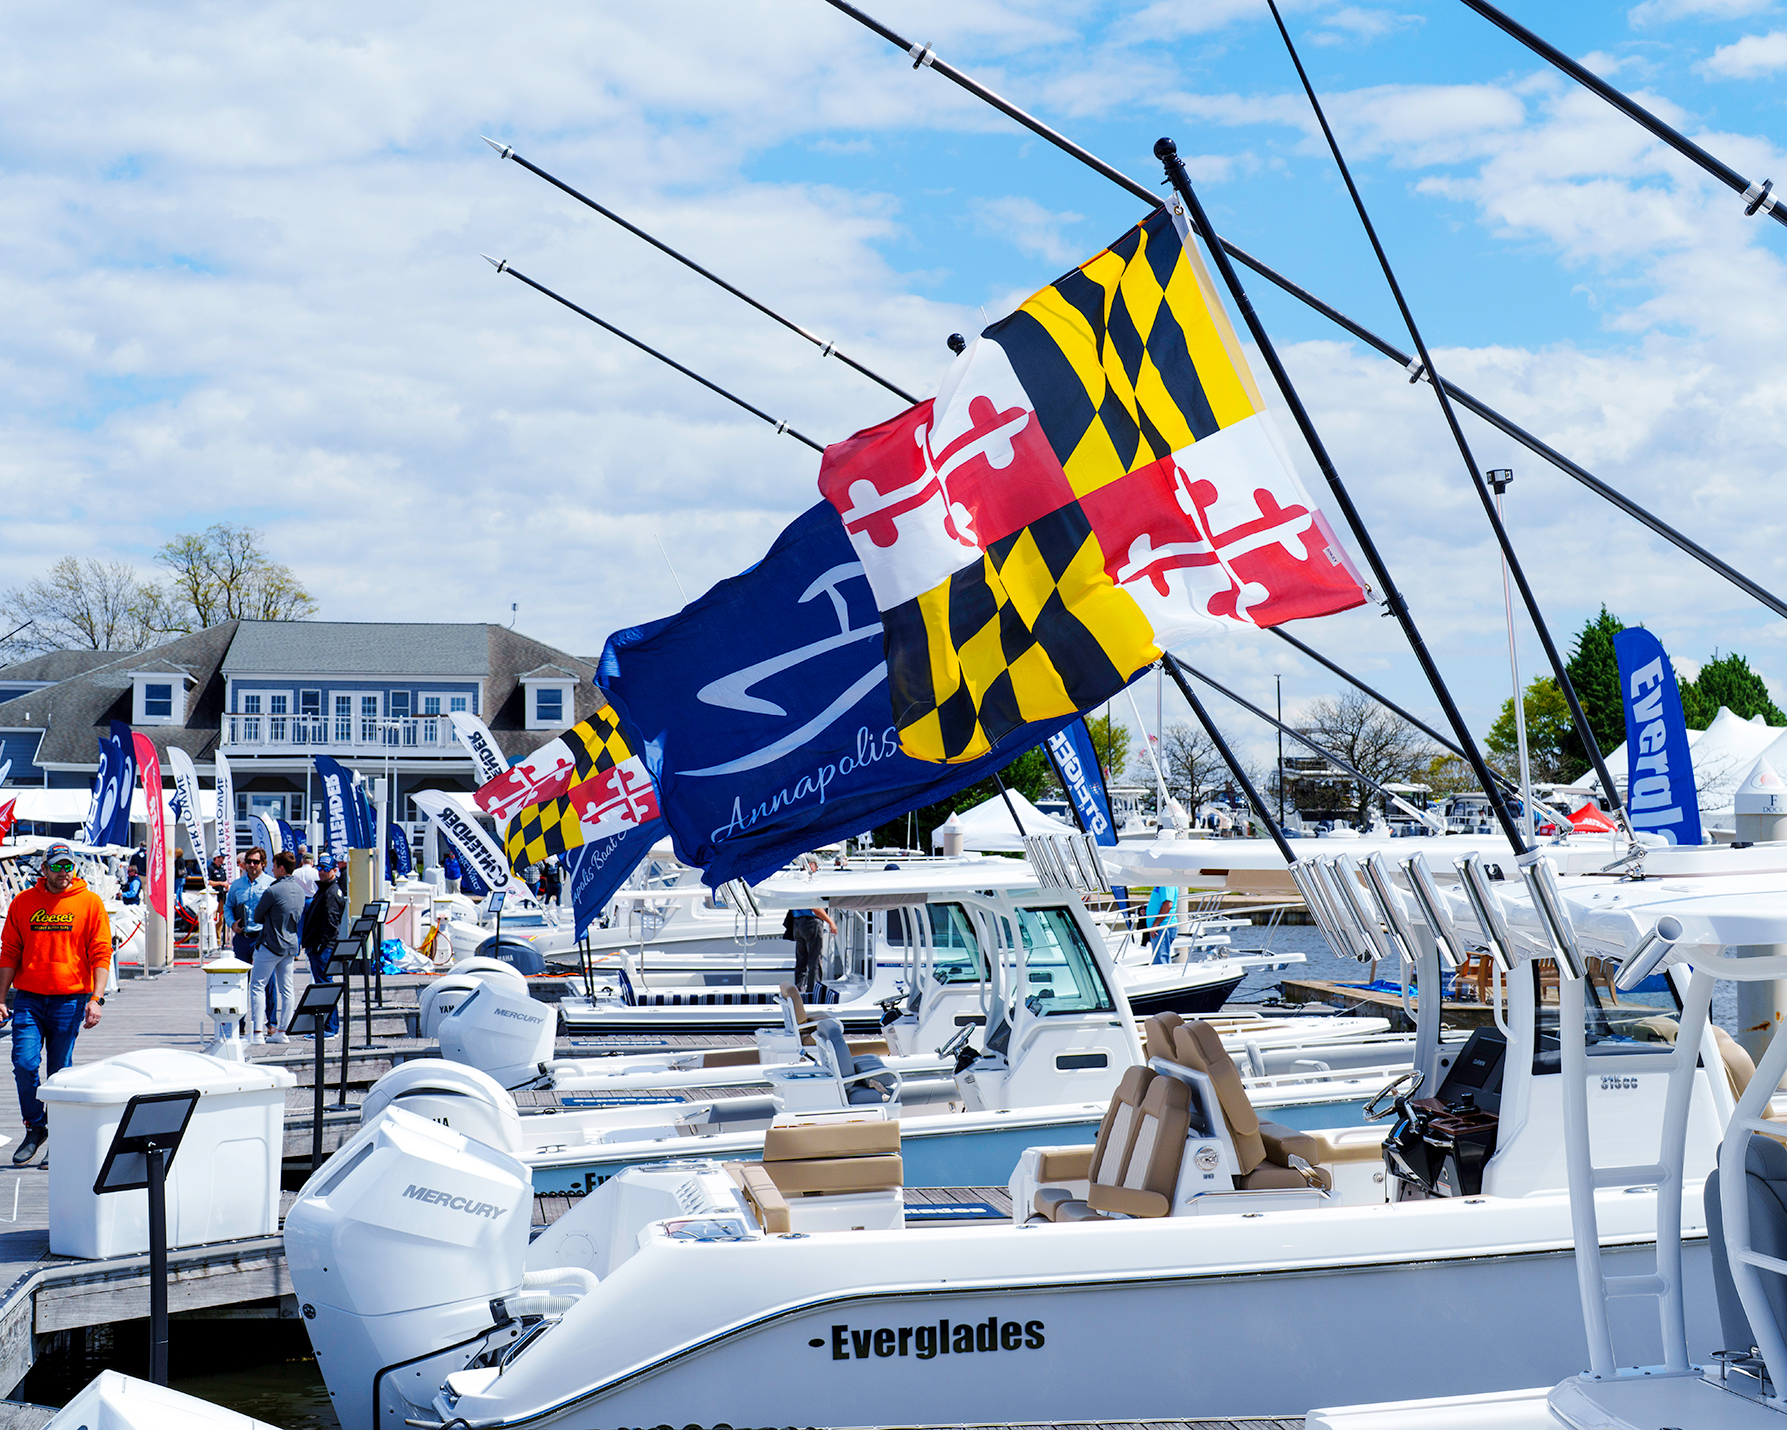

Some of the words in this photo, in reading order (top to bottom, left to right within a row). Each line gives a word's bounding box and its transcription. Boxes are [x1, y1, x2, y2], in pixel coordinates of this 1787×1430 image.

[710, 726, 898, 843] Annapolis
[1770, 794, 1778, 806] F
[591, 836, 618, 870] Boat
[29, 908, 74, 923] Reese's
[497, 954, 514, 962] MAHA
[439, 1005, 455, 1014] YAM
[494, 1008, 544, 1025] MERCURY
[402, 1184, 508, 1220] MERCURY
[831, 1316, 1046, 1360] Everglades
